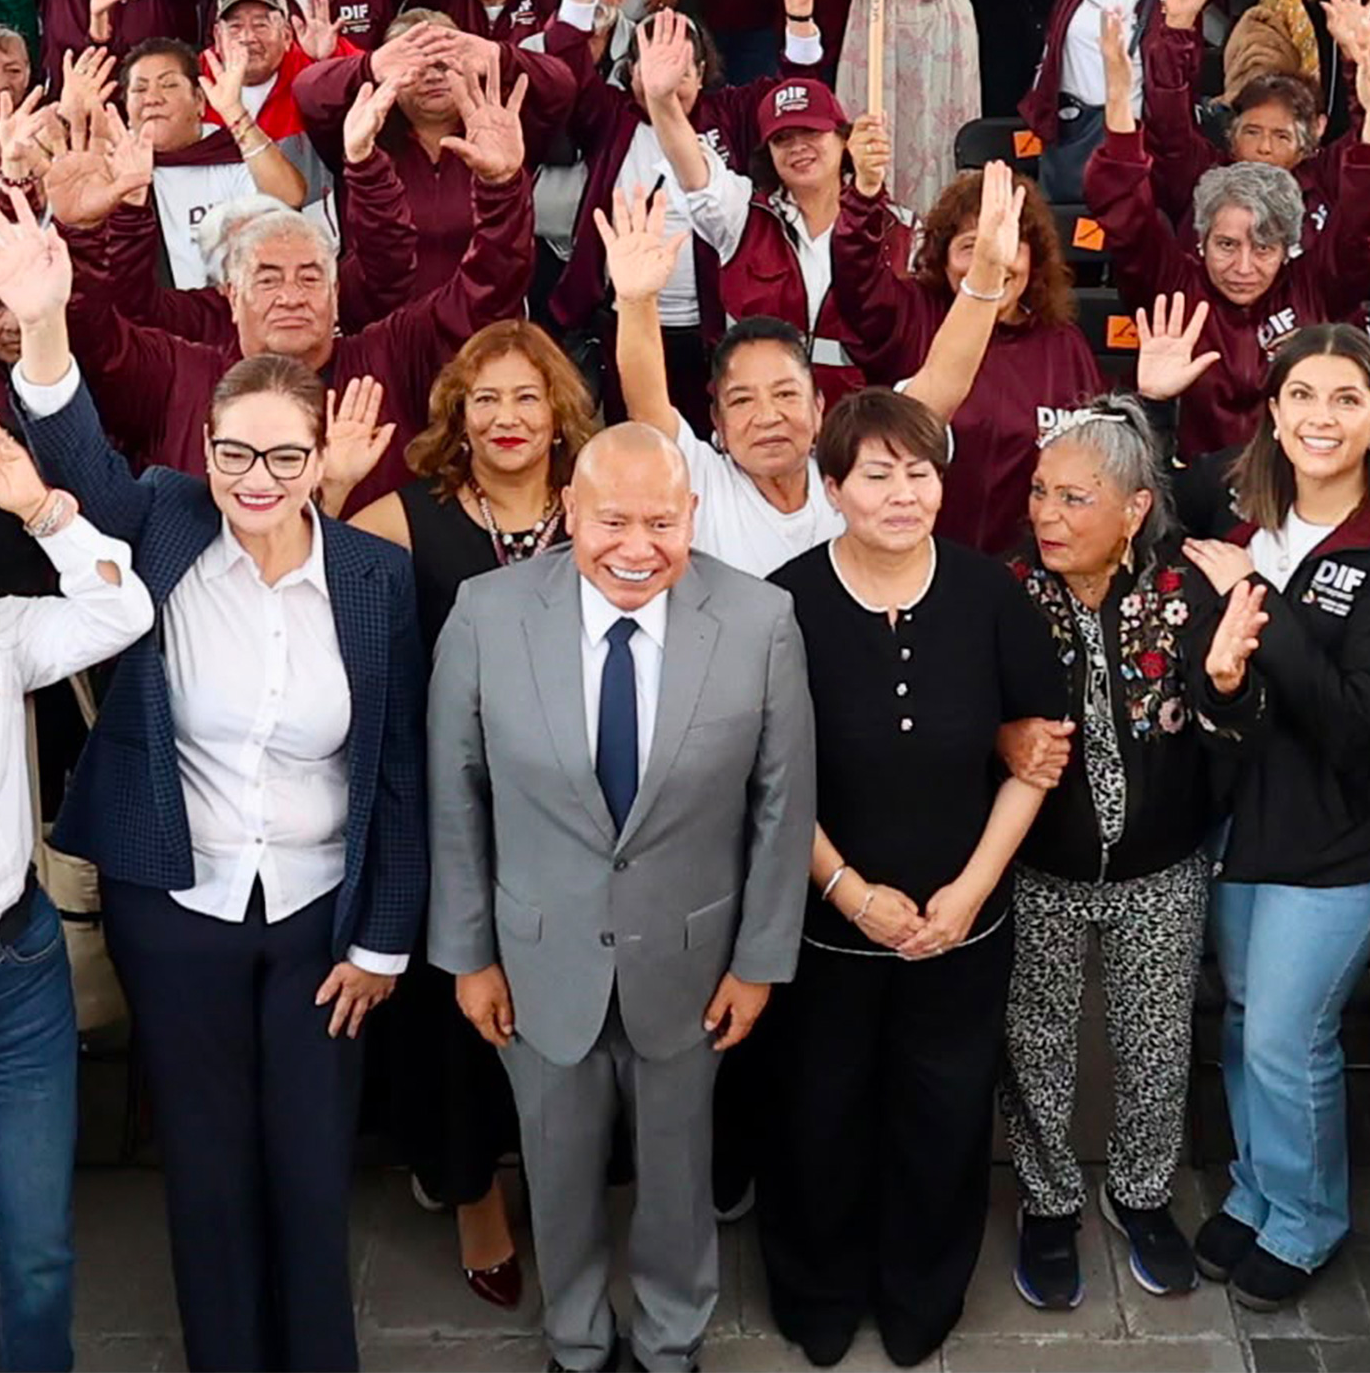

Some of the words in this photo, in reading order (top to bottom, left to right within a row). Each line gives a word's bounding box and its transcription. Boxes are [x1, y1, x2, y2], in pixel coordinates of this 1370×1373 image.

[340, 4, 369, 21] DIF
[775, 85, 807, 103] DIF
[1313, 559, 1367, 593] DIF
